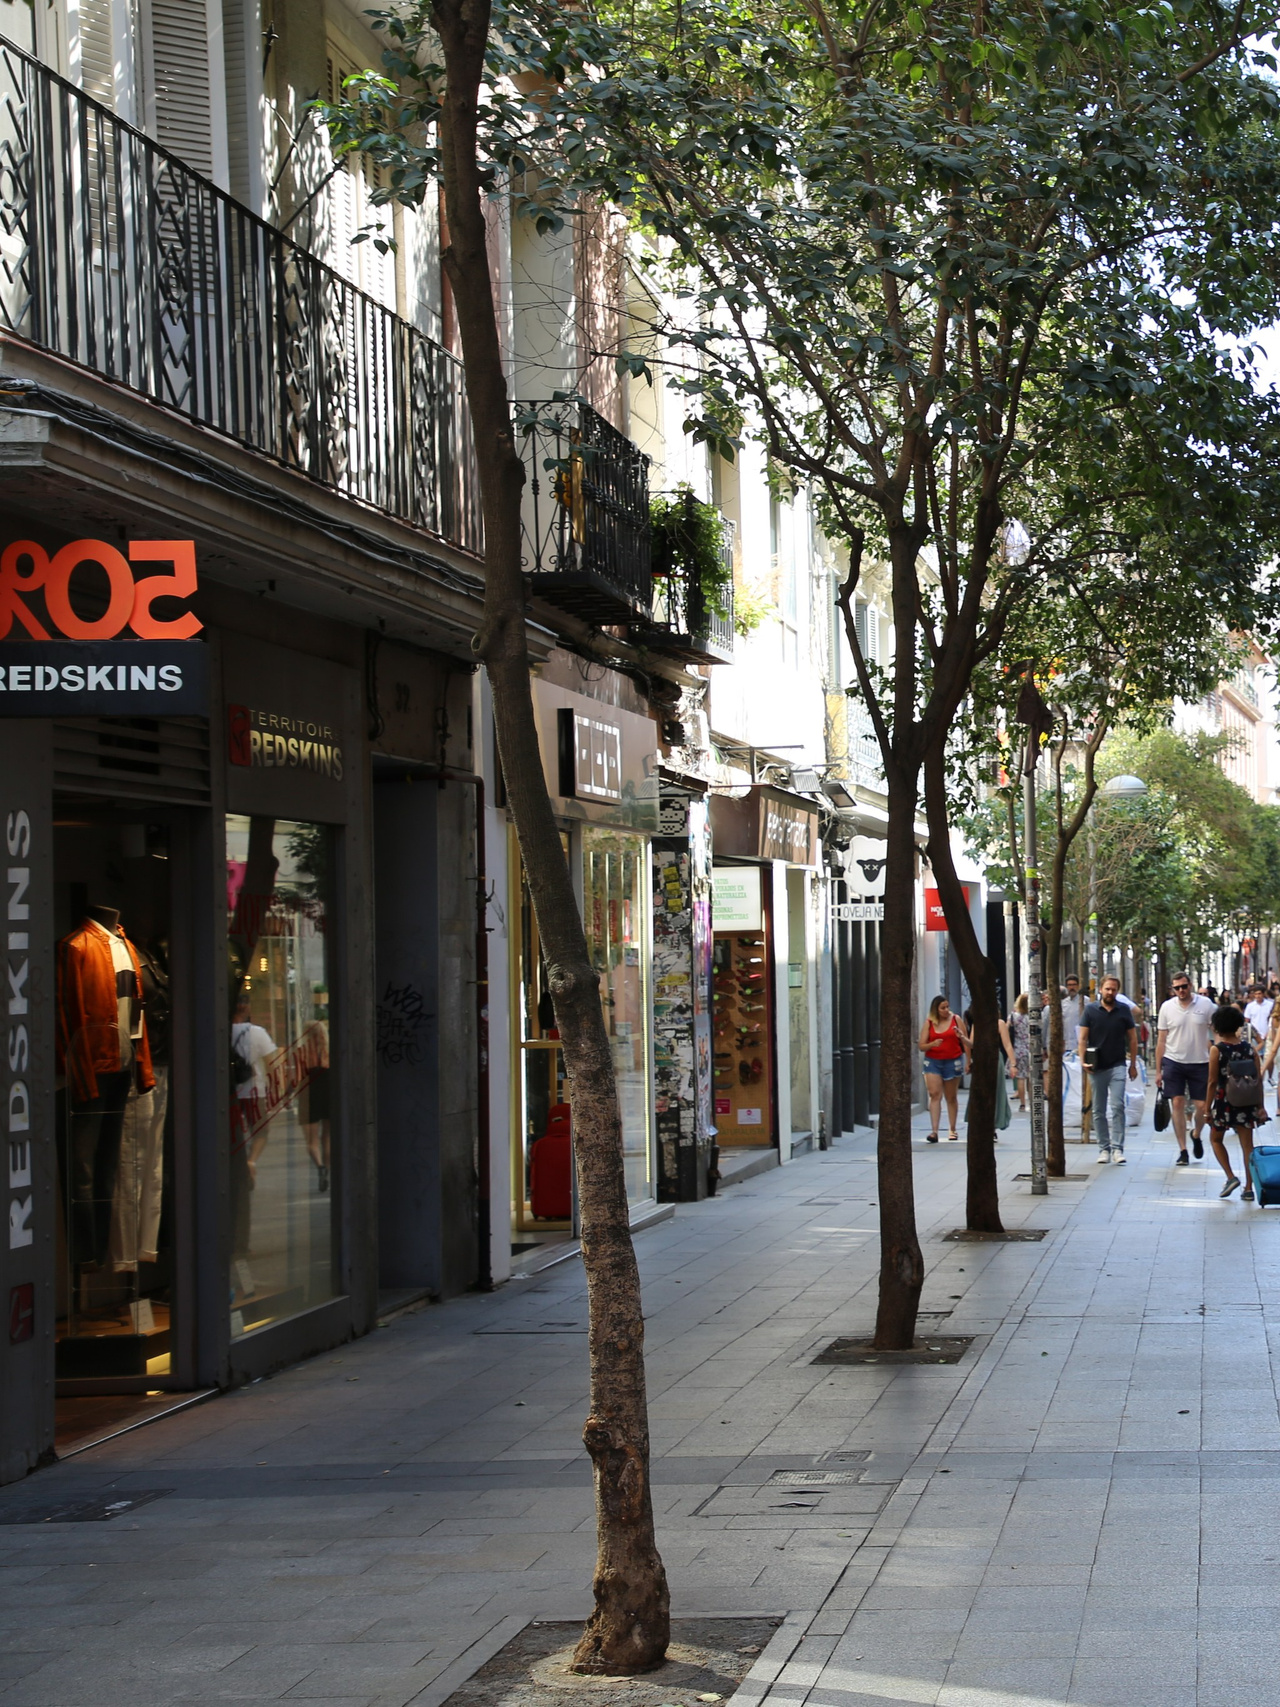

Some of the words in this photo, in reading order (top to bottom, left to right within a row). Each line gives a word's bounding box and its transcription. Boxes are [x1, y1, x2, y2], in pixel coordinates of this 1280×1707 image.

[249, 730, 344, 782] REDSKINS
[843, 906, 872, 918] OVEJA
[7, 810, 34, 1250] REDSKINS
